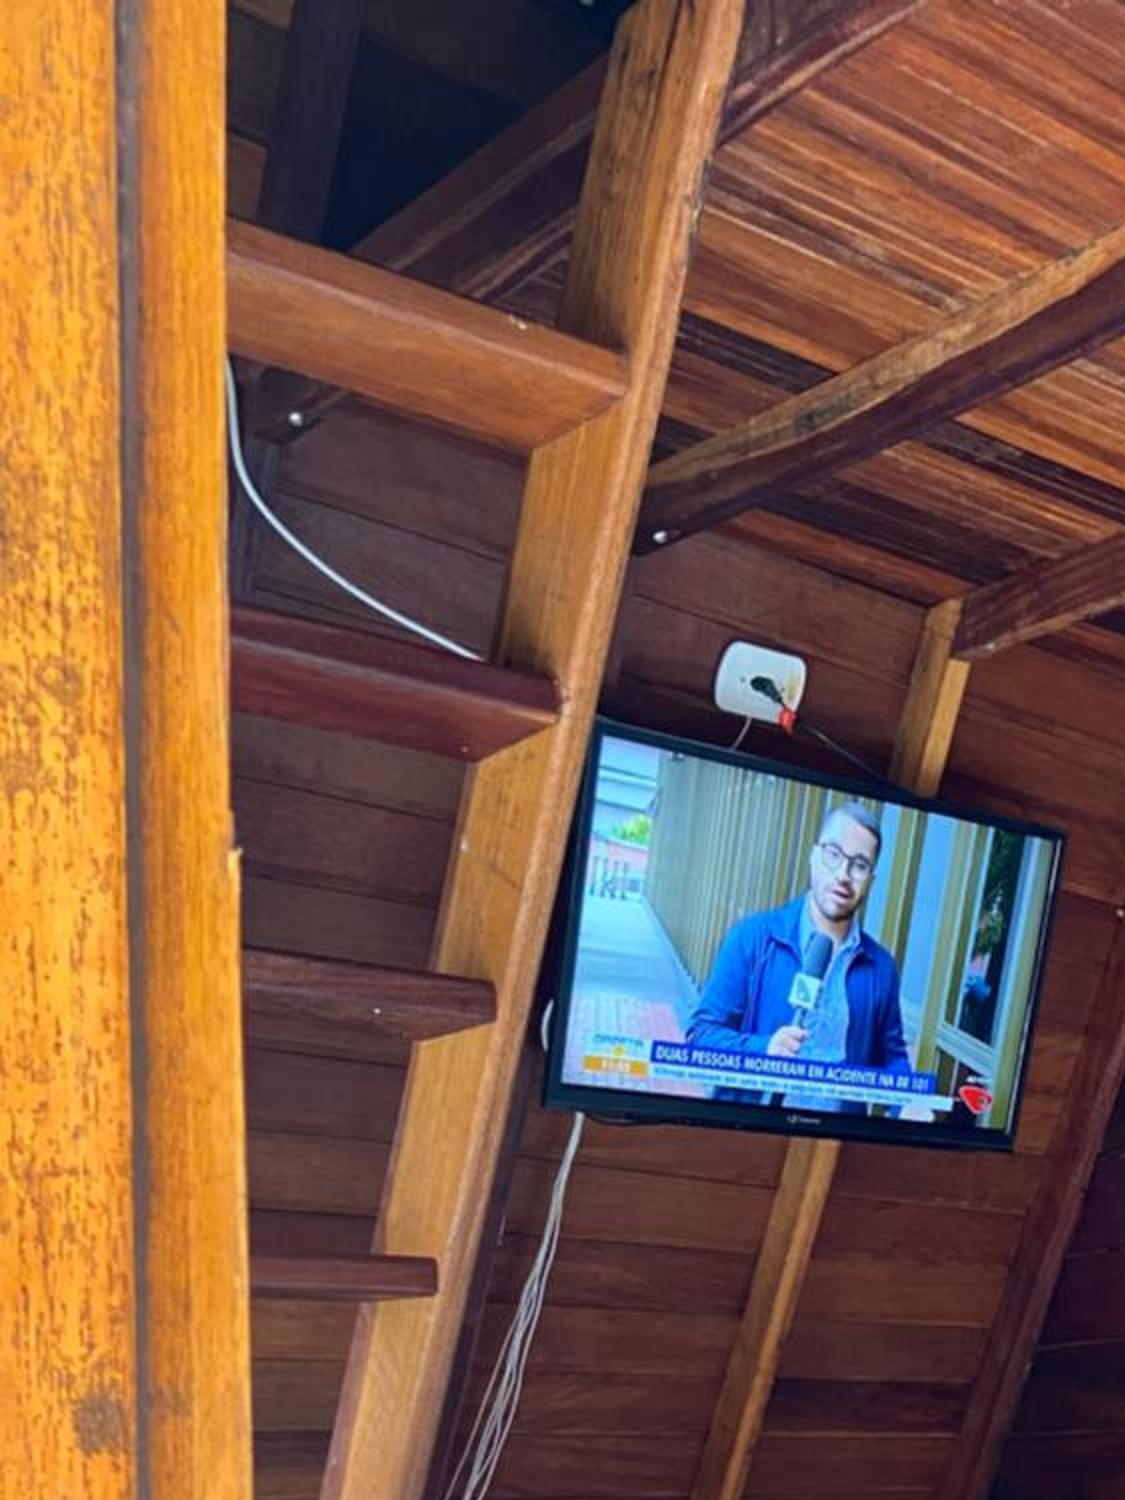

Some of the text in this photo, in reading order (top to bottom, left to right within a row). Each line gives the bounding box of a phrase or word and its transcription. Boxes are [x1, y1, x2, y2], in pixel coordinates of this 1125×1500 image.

[655, 1045, 688, 1062] DUAS
[692, 1049, 741, 1069] PESSOAS
[744, 1056, 806, 1076] MORRERAM
[826, 1067, 876, 1085] ACIDENTE
